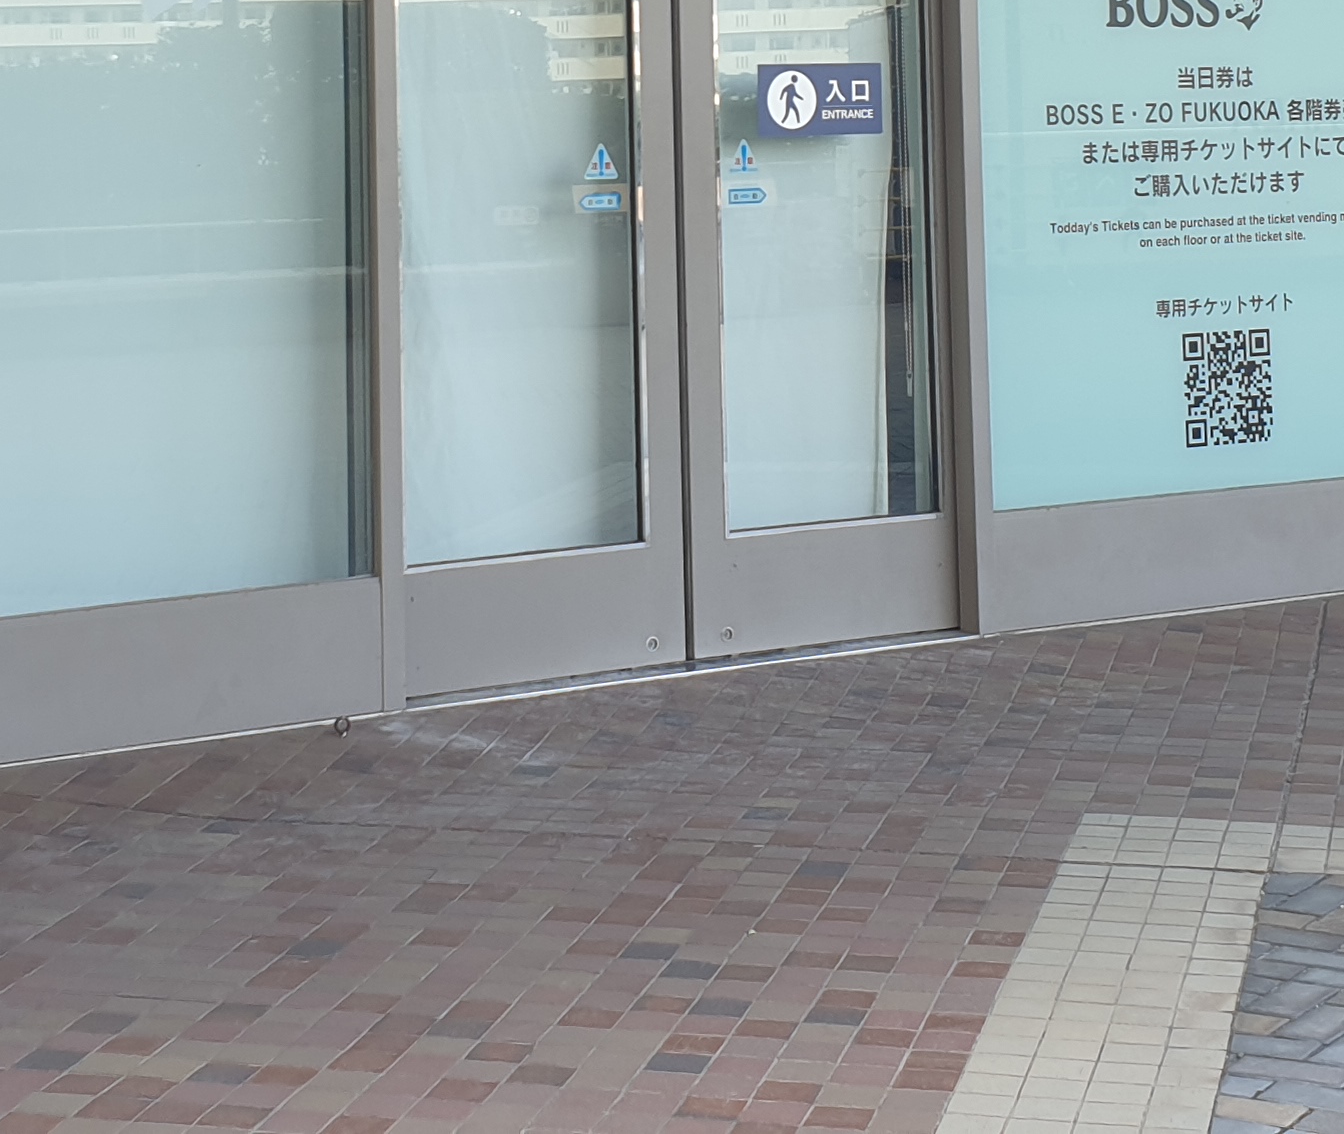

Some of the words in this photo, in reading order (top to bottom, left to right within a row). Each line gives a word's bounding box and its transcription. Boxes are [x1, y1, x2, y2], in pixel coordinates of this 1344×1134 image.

[1177, 67, 1253, 90] 当日券は
[825, 79, 870, 103] 入口
[822, 109, 874, 120] ENTRANCE
[1046, 104, 1104, 125] BOSS
[1181, 101, 1281, 123] FUKUOKA
[1134, 170, 1305, 198] ご購入いただけます
[1050, 222, 1098, 235] Todday's
[1102, 220, 1139, 232] Tickets
[1143, 220, 1161, 230] can
[1164, 218, 1177, 229] be
[1180, 216, 1234, 230] purchased
[1237, 216, 1247, 225] at
[1249, 215, 1265, 225] the
[1268, 213, 1295, 224] ticket
[1298, 212, 1337, 224] vending
[1139, 237, 1153, 247] on
[1156, 236, 1180, 247] each
[1183, 235, 1207, 246] floor
[1210, 235, 1221, 244] or
[1224, 234, 1234, 243] at
[1236, 232, 1252, 243] the
[1255, 231, 1282, 242] ticket
[1285, 230, 1306, 241] site.
[1156, 293, 1294, 318] 専用チケットサイト
